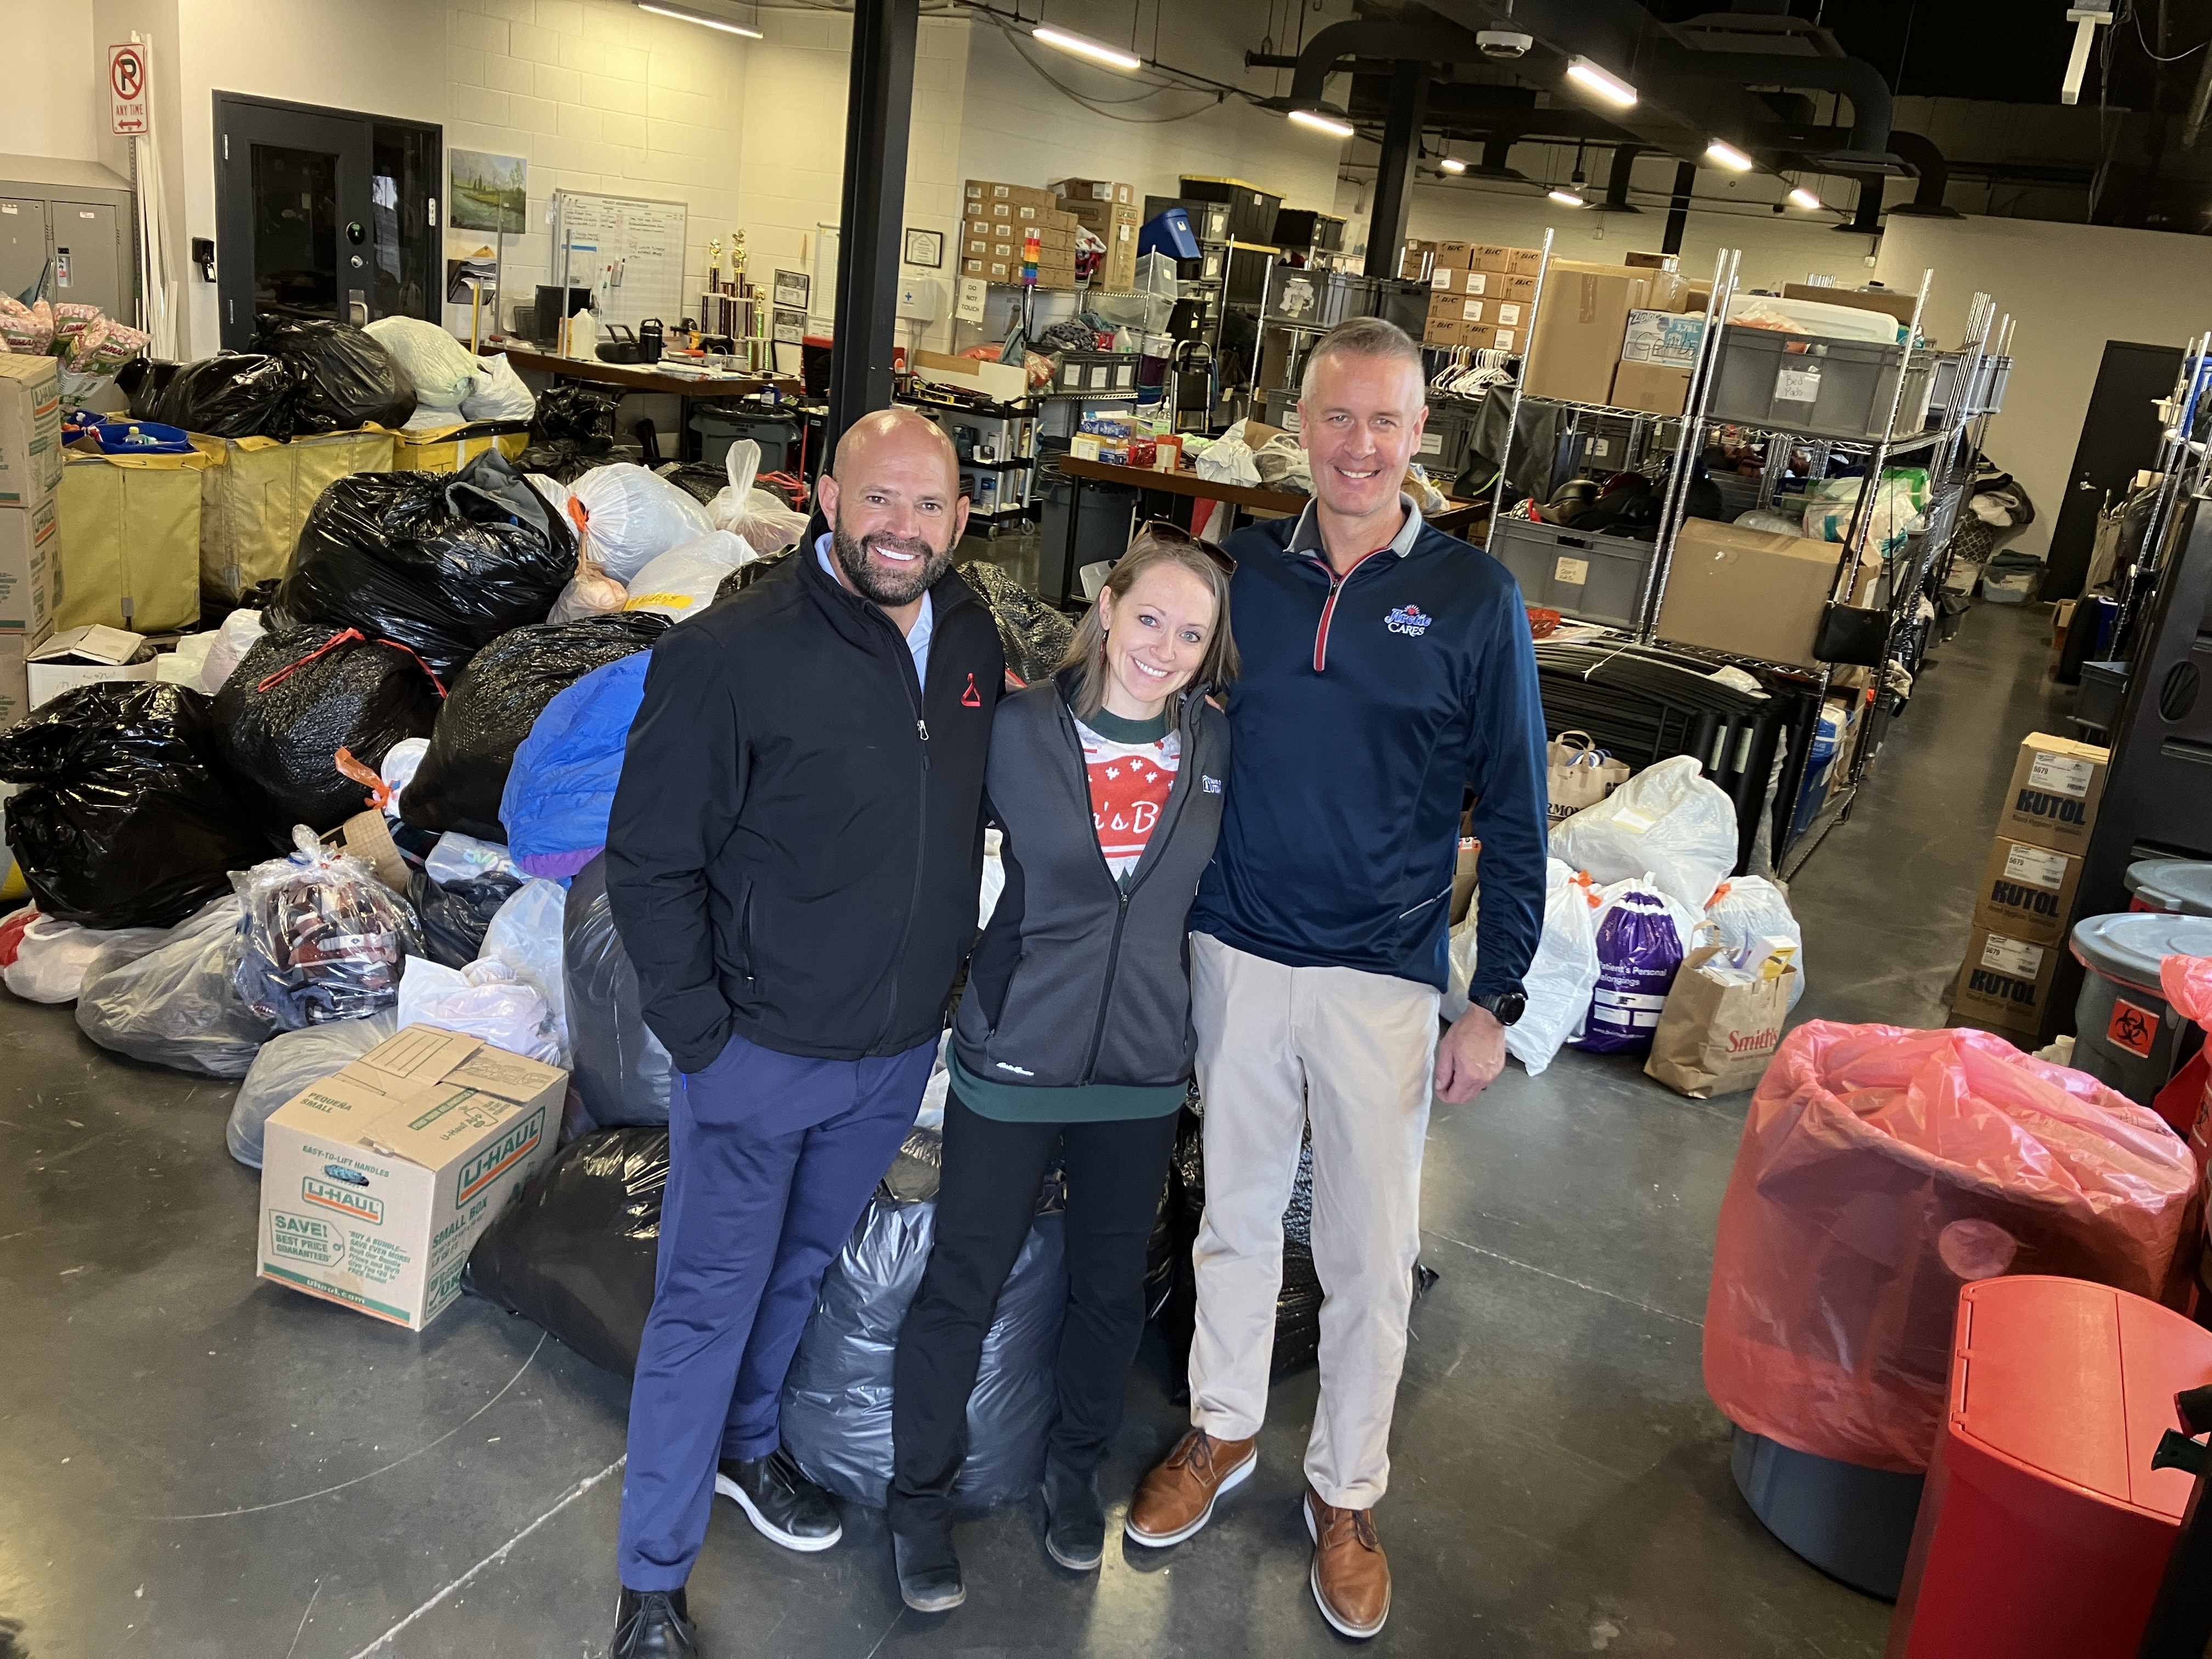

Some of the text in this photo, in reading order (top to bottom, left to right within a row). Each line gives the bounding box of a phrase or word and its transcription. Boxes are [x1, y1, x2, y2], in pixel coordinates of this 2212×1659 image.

[116, 104, 143, 116] ANY TIME
[961, 303, 980, 312] TOUCH
[1786, 374, 1803, 387] Bed
[1785, 386, 1803, 397] Pads
[1384, 608, 1432, 627] Arctic
[1387, 622, 1426, 637] CARES
[2016, 788, 2087, 826] KUTOL
[1990, 879, 2059, 918] KUTOL
[1600, 960, 1667, 977] atient's Personal
[1600, 973, 1641, 987] elongings
[1968, 968, 2037, 1007] KUTOL
[1725, 1028, 1778, 1053] Smith's
[300, 1098, 334, 1114] SMALL
[308, 1092, 352, 1111] PEQUEÑA
[439, 1121, 468, 1141] U-Haul
[302, 1145, 390, 1178] EASY-TO-LIFT HANDLES
[464, 1119, 538, 1188] U-HAUL
[307, 1182, 379, 1214] U-HAUL
[275, 1215, 328, 1238] SAVE!
[432, 1214, 466, 1250] SMALL
[469, 1195, 488, 1220] BOX
[275, 1234, 328, 1252] BEST PRICE
[306, 1279, 365, 1304] uhaul.com
